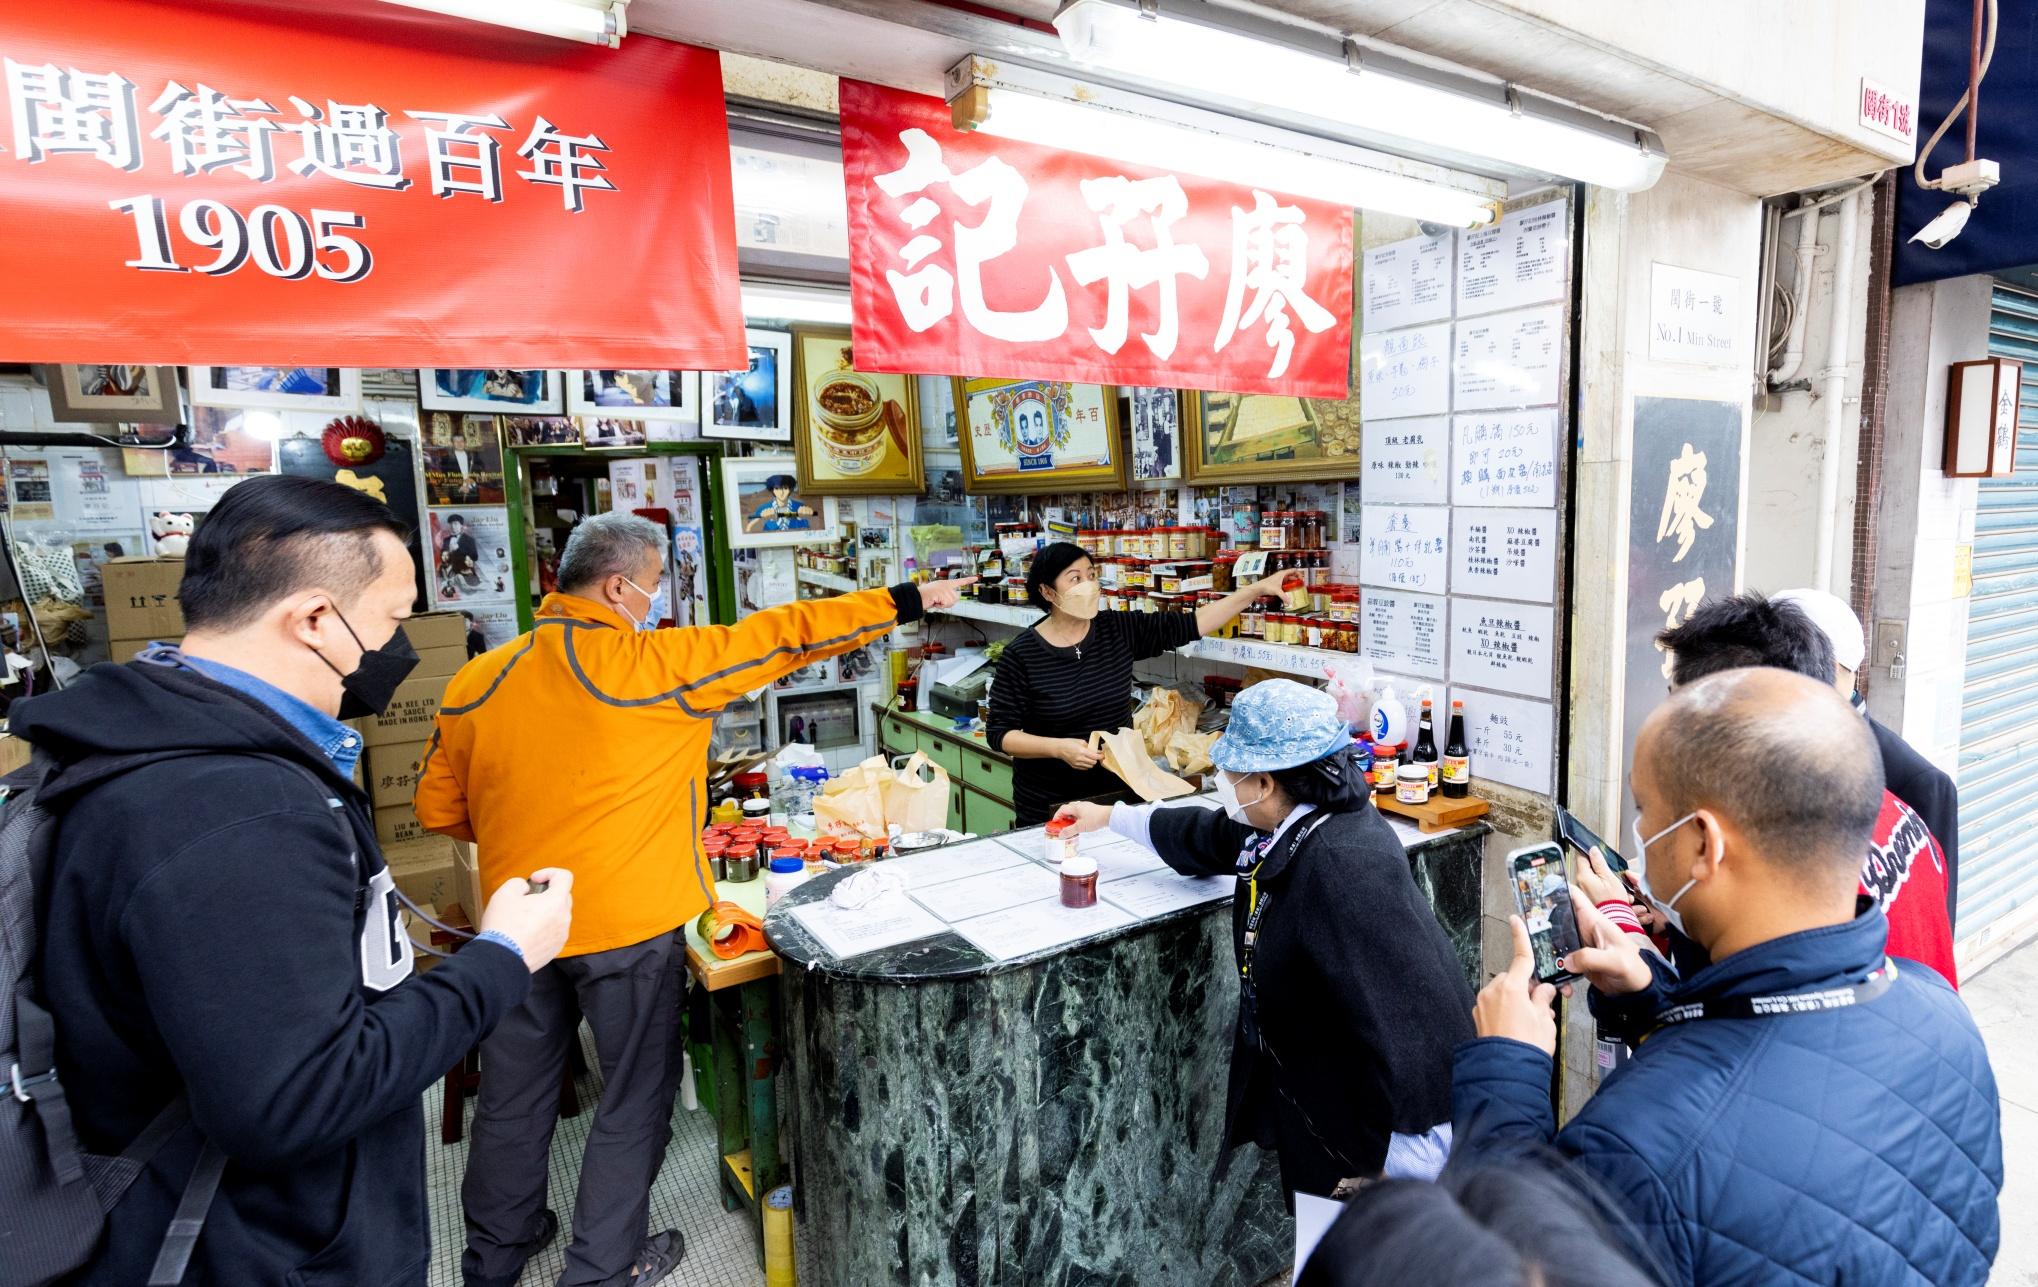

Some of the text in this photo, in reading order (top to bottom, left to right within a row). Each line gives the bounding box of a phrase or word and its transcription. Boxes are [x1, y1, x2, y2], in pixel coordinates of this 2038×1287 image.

[0, 56, 621, 213] 閩街過百年
[110, 193, 374, 282] 1905
[1687, 330, 1704, 346] Min
[1707, 334, 1731, 350] Street
[1480, 637, 1518, 652] XO 辣椒醬
[391, 698, 435, 709] MA KEE LTD
[403, 707, 426, 716] SAUCE
[377, 718, 397, 727] MADE
[408, 715, 427, 723] HONG
[1503, 729, 1513, 740] 55
[1515, 733, 1523, 743] 元
[1503, 743, 1512, 753] 30
[1515, 746, 1524, 756] 元
[380, 774, 418, 791] 廖孖
[394, 823, 406, 833] LIU
[395, 830, 413, 839] BEAN
